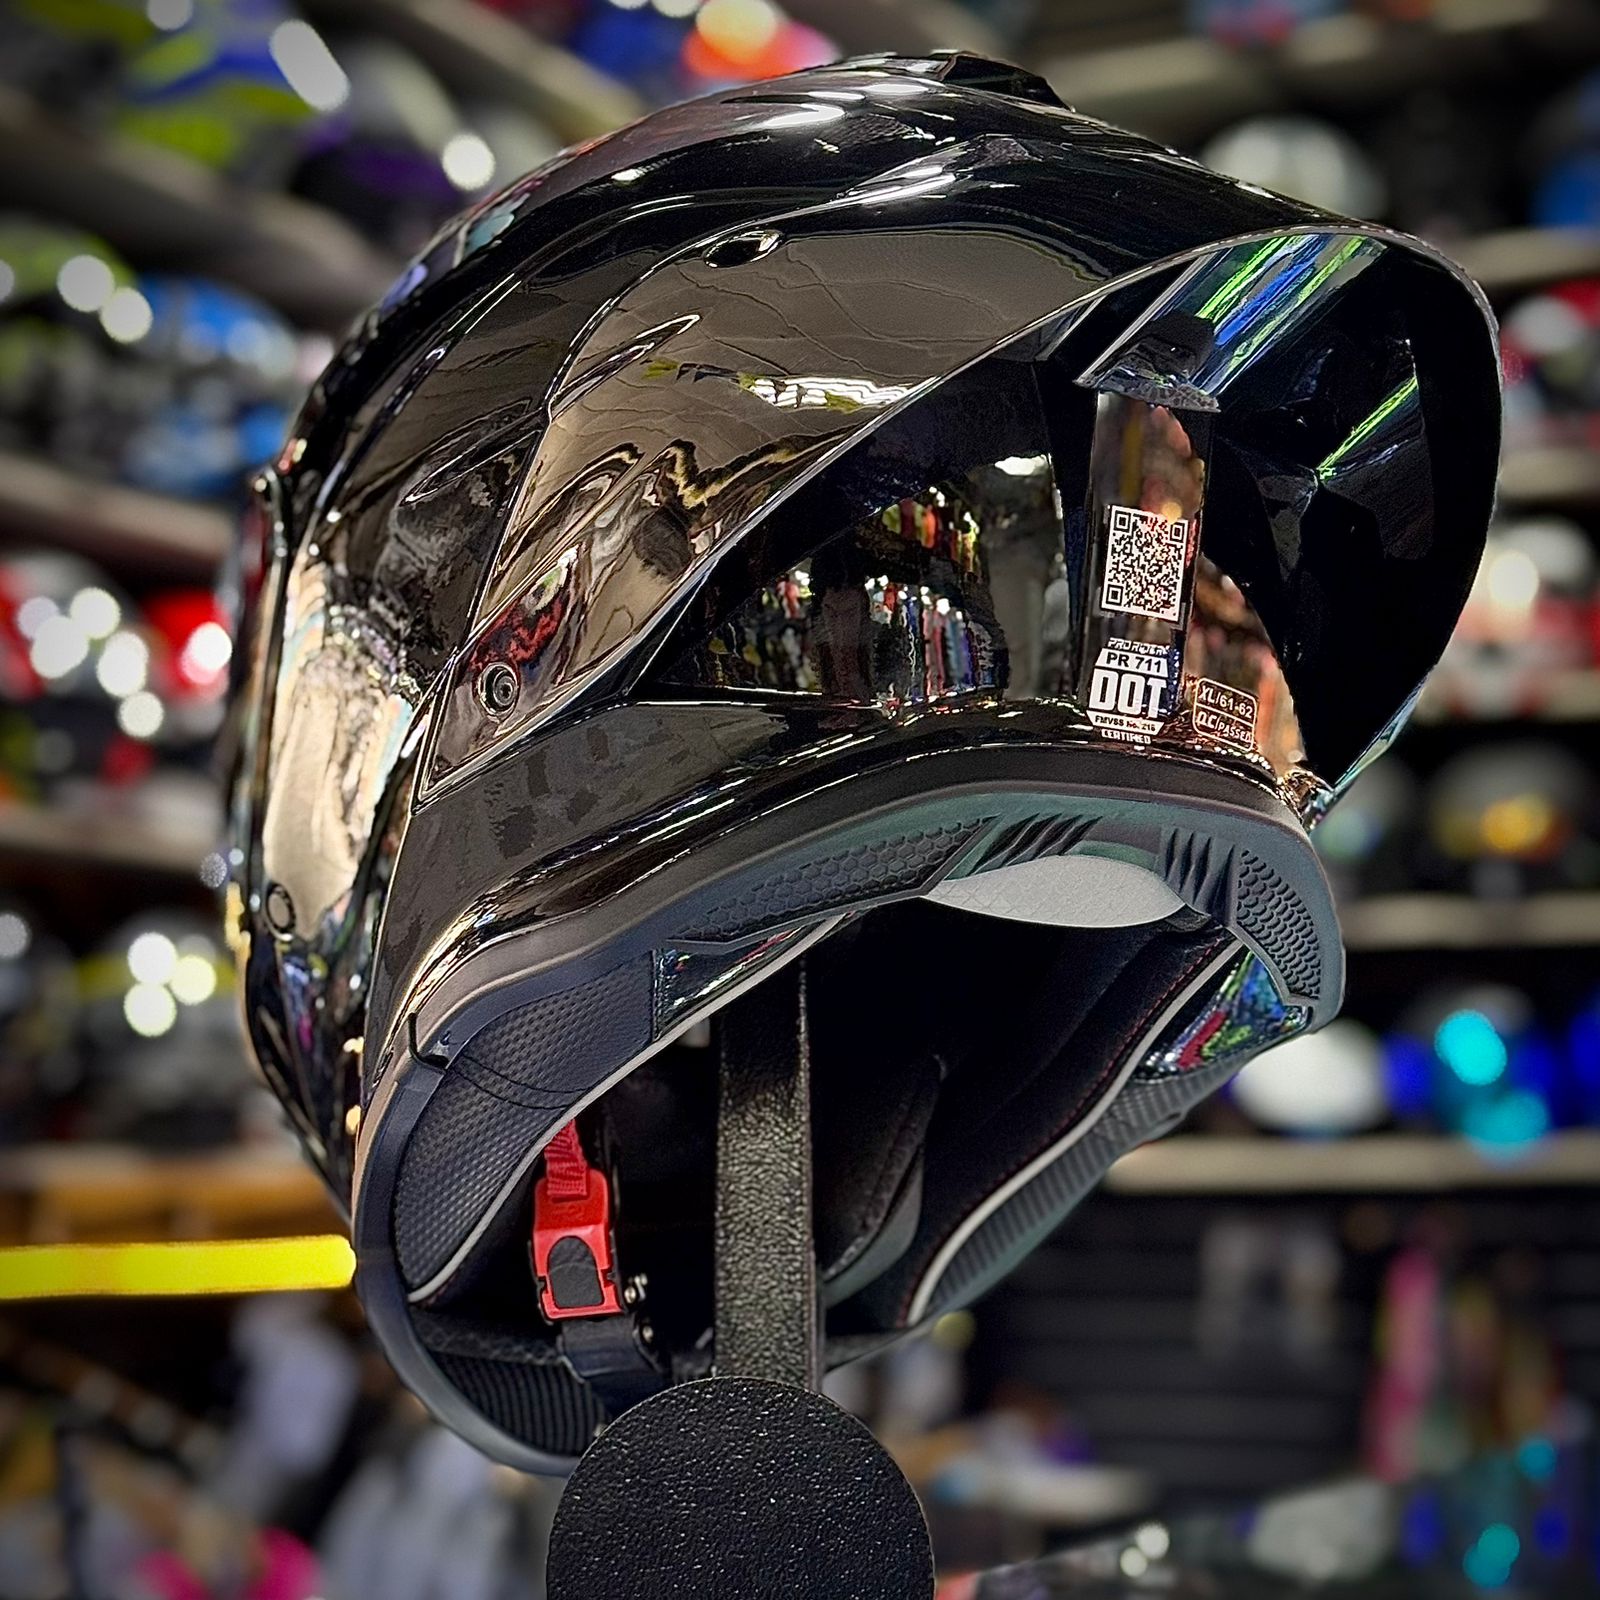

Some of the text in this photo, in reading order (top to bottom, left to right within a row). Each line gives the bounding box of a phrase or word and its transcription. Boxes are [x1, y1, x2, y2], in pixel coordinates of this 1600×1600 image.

[1106, 652, 1162, 673] PR 711
[1088, 668, 1168, 719] DOT
[1102, 728, 1152, 745] CERTIFIED
